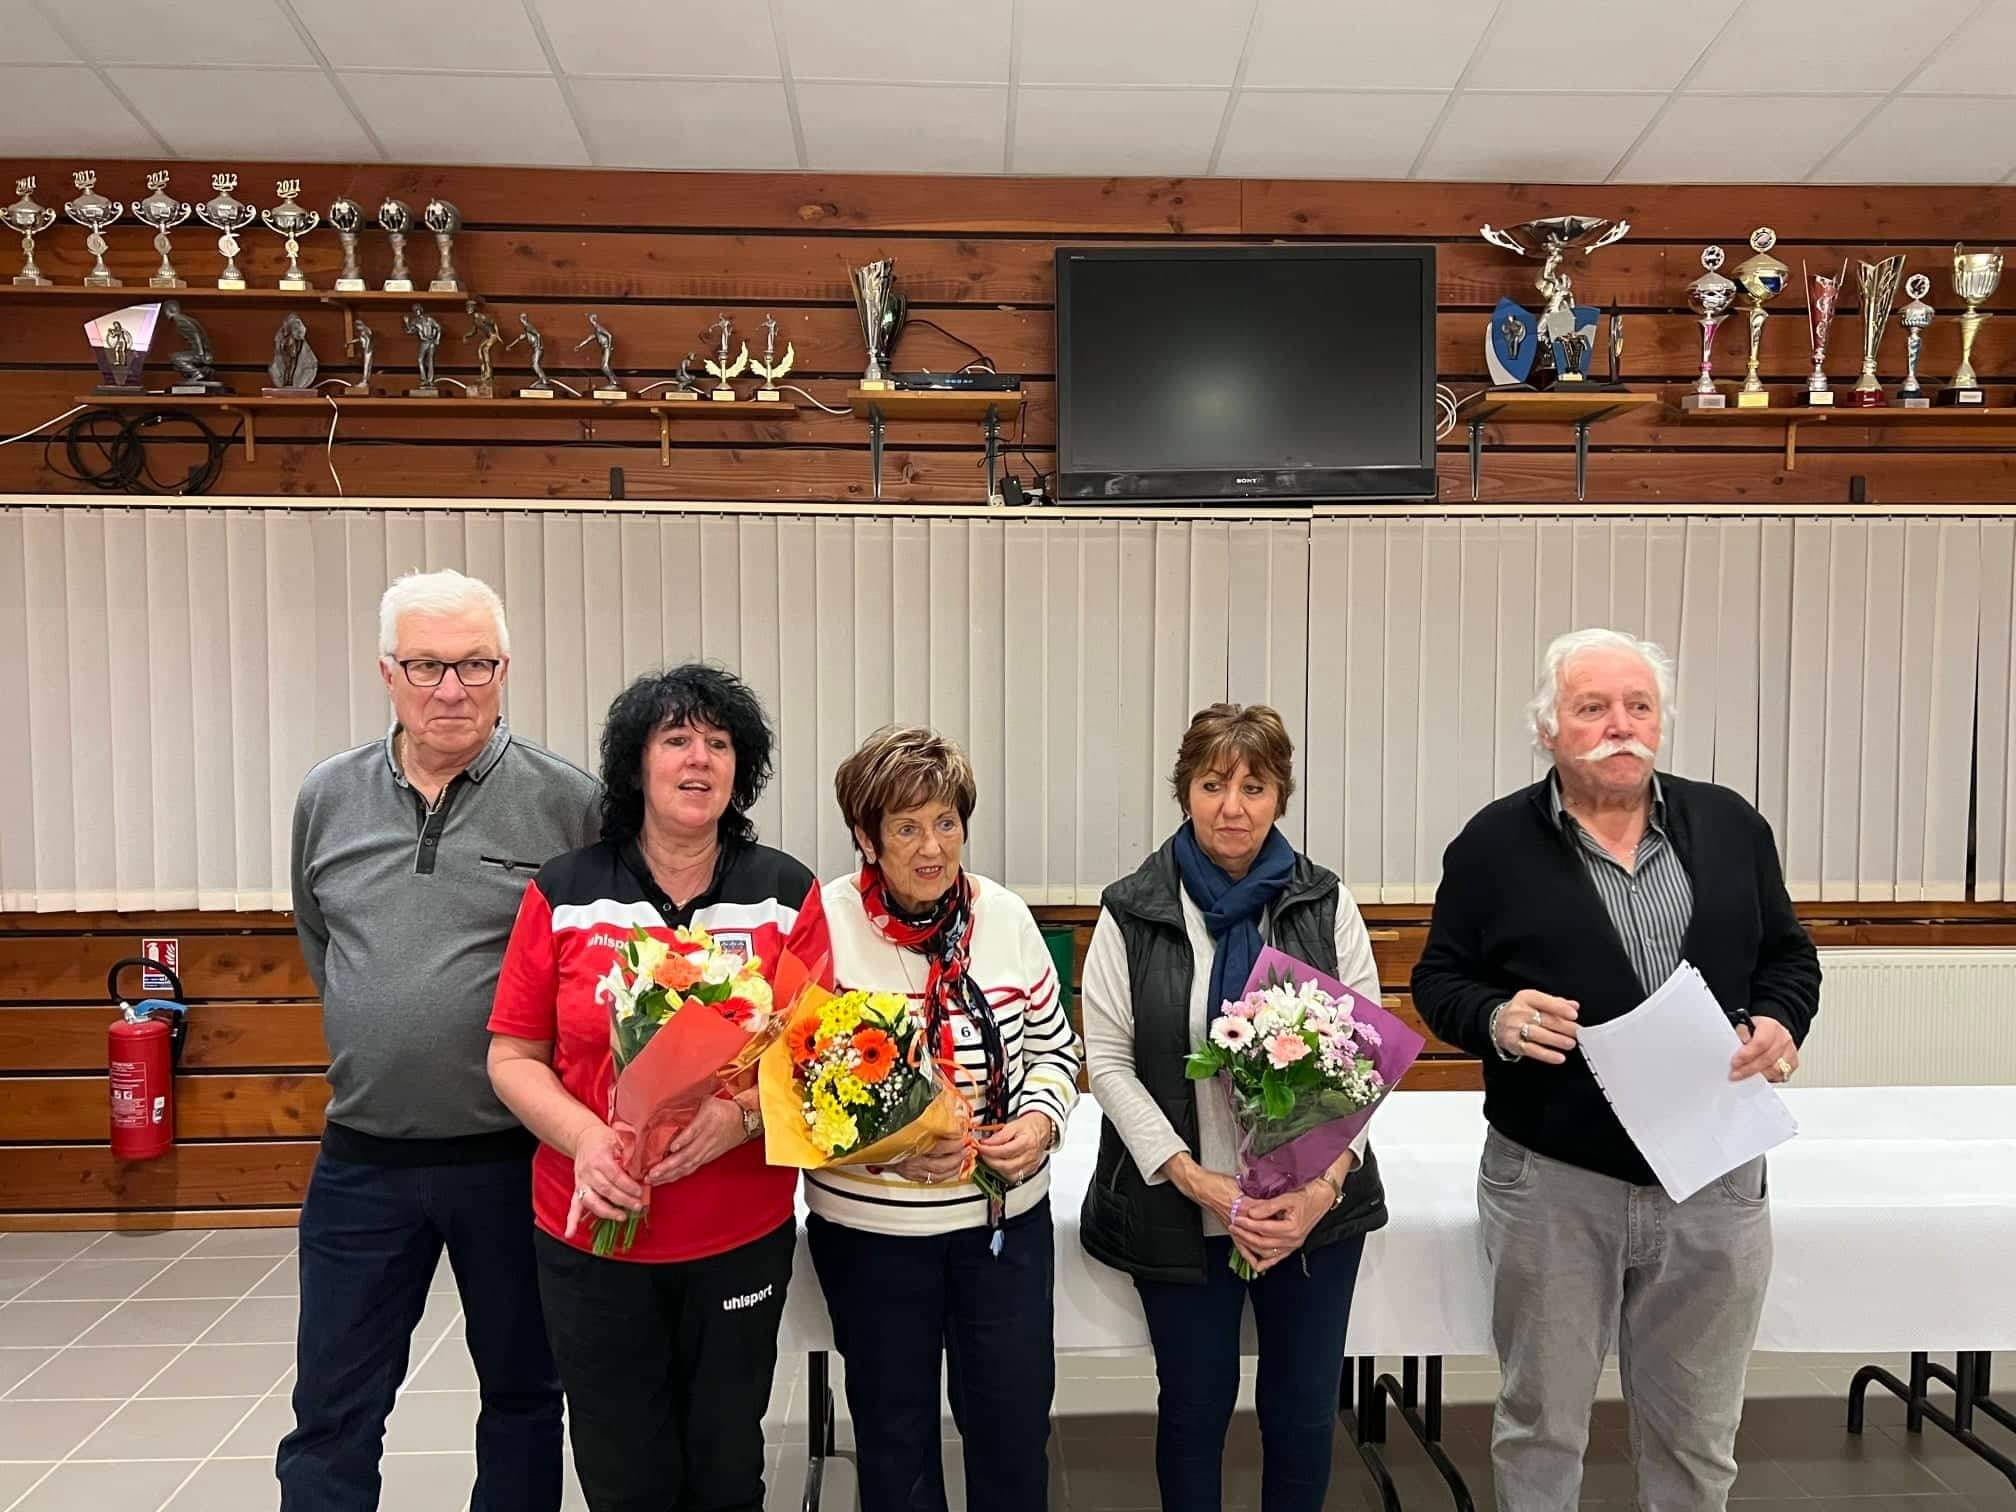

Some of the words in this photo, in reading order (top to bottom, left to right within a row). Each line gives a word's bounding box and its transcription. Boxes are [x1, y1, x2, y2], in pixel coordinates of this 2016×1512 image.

[15, 175, 37, 192] 2011
[73, 169, 96, 184] 2012
[147, 170, 170, 185] 2012
[211, 173, 238, 187] 2012
[276, 179, 301, 193] 2011
[961, 1026, 971, 1038] 6
[723, 1283, 773, 1311] uhlsport
